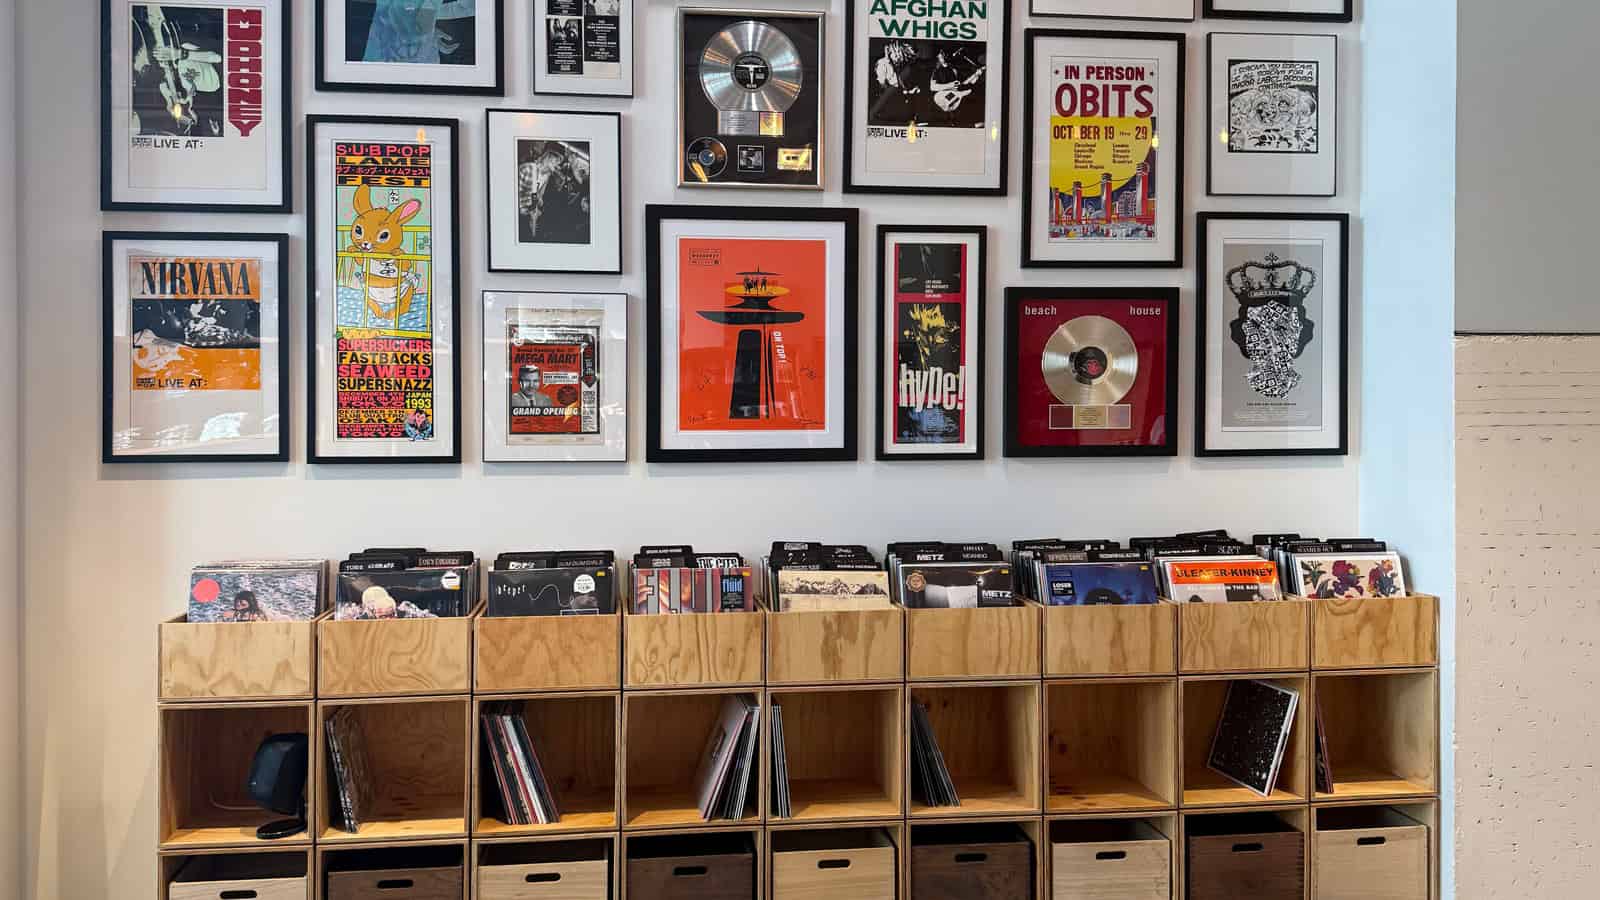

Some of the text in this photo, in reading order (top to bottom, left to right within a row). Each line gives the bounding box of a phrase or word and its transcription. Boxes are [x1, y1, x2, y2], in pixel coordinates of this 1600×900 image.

[870, 0, 987, 19] AFGHAN
[879, 18, 977, 39] WHIGS
[1064, 65, 1145, 80] IN PERSON
[1055, 83, 1154, 118] OBITS
[885, 129, 907, 138] LIVE
[1053, 125, 1100, 140] OCTBER
[1104, 126, 1115, 140] 19
[1135, 126, 1148, 140] 29
[154, 139, 180, 149] LIVE
[185, 139, 203, 149] AT:
[338, 157, 430, 166] LAME
[338, 175, 430, 186] FEST
[141, 262, 251, 295] NIRVANA
[1024, 306, 1161, 316] beach house
[338, 339, 431, 352] SUPERSUCKERS
[339, 352, 431, 364] FASTBACKS
[515, 352, 577, 364] MEGA MART
[338, 365, 431, 378] SEAWEED
[159, 378, 184, 388] LIVE
[189, 378, 208, 388] AT:
[339, 378, 431, 391] SUPERSNAZZ
[899, 363, 966, 413] hype!
[405, 399, 432, 409] 1993
[512, 407, 541, 416] GRAND
[981, 589, 1012, 598] METZ
